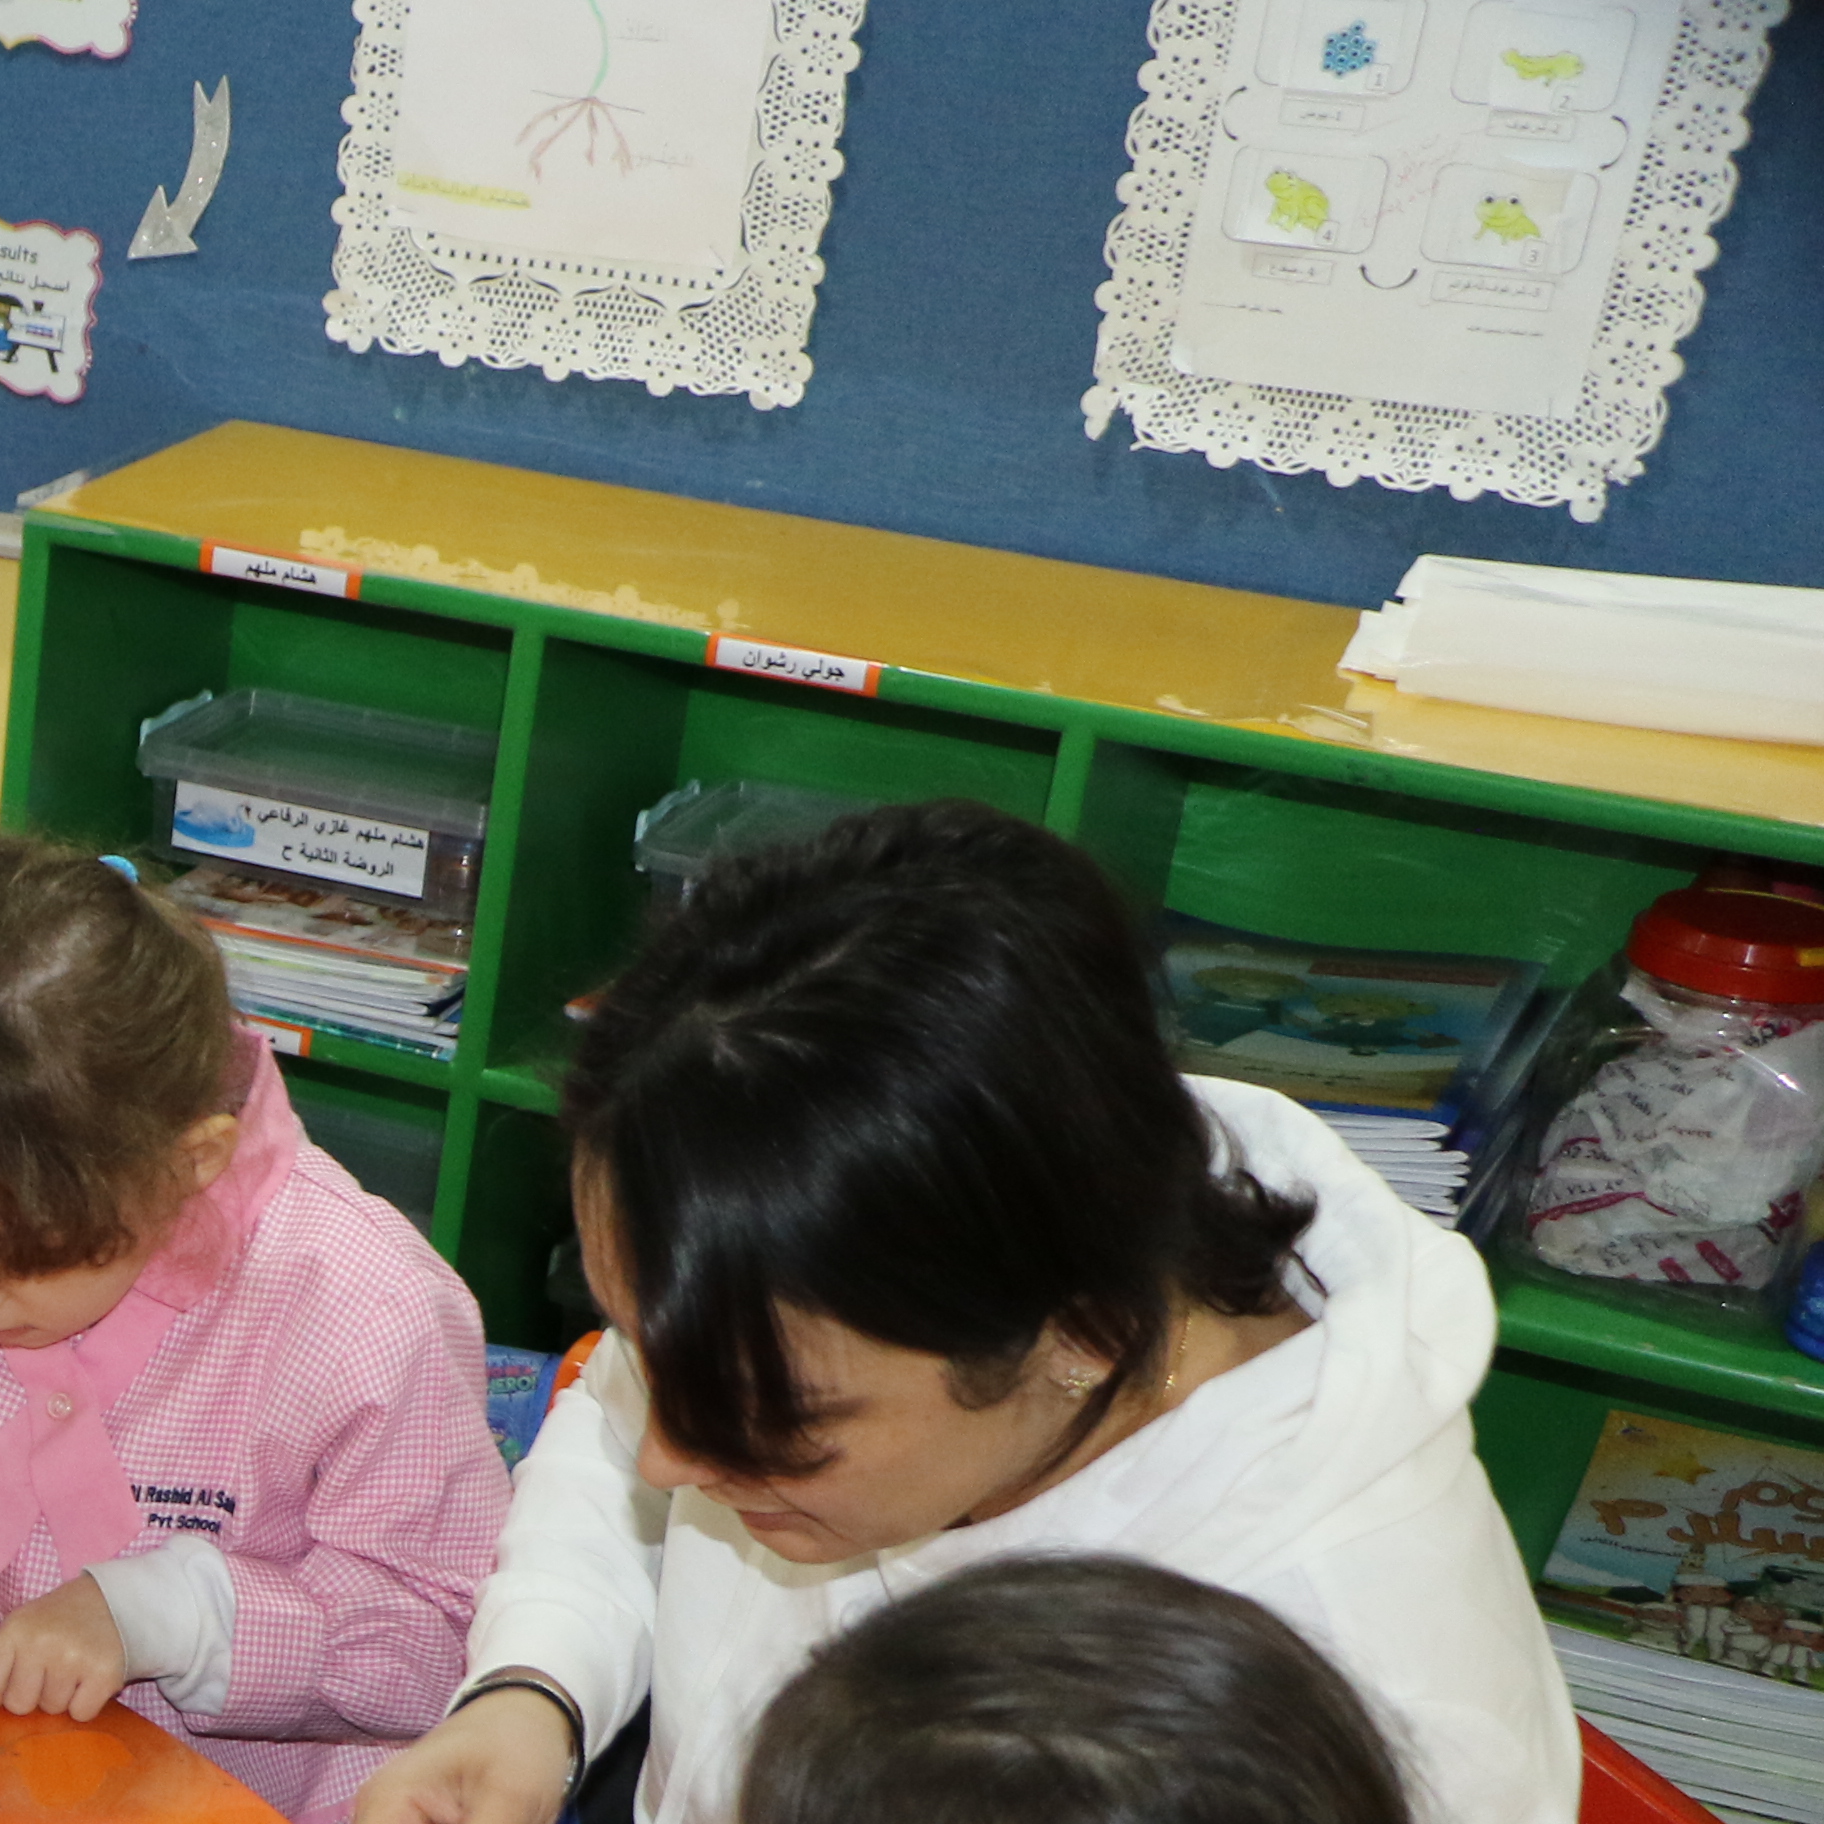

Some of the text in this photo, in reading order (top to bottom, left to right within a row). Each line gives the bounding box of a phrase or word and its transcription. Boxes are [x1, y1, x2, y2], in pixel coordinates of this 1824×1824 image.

[245, 560, 317, 585] هشام ملهم
[742, 650, 846, 681] جولي رشوان
[257, 805, 425, 851] هشام ملهم غازي الرفاعي
[299, 842, 338, 864] الثانية
[342, 851, 394, 878] الروضة
[145, 1485, 193, 1505] Rashid
[195, 1487, 213, 1506] Al
[147, 1512, 222, 1535] Pvt School
